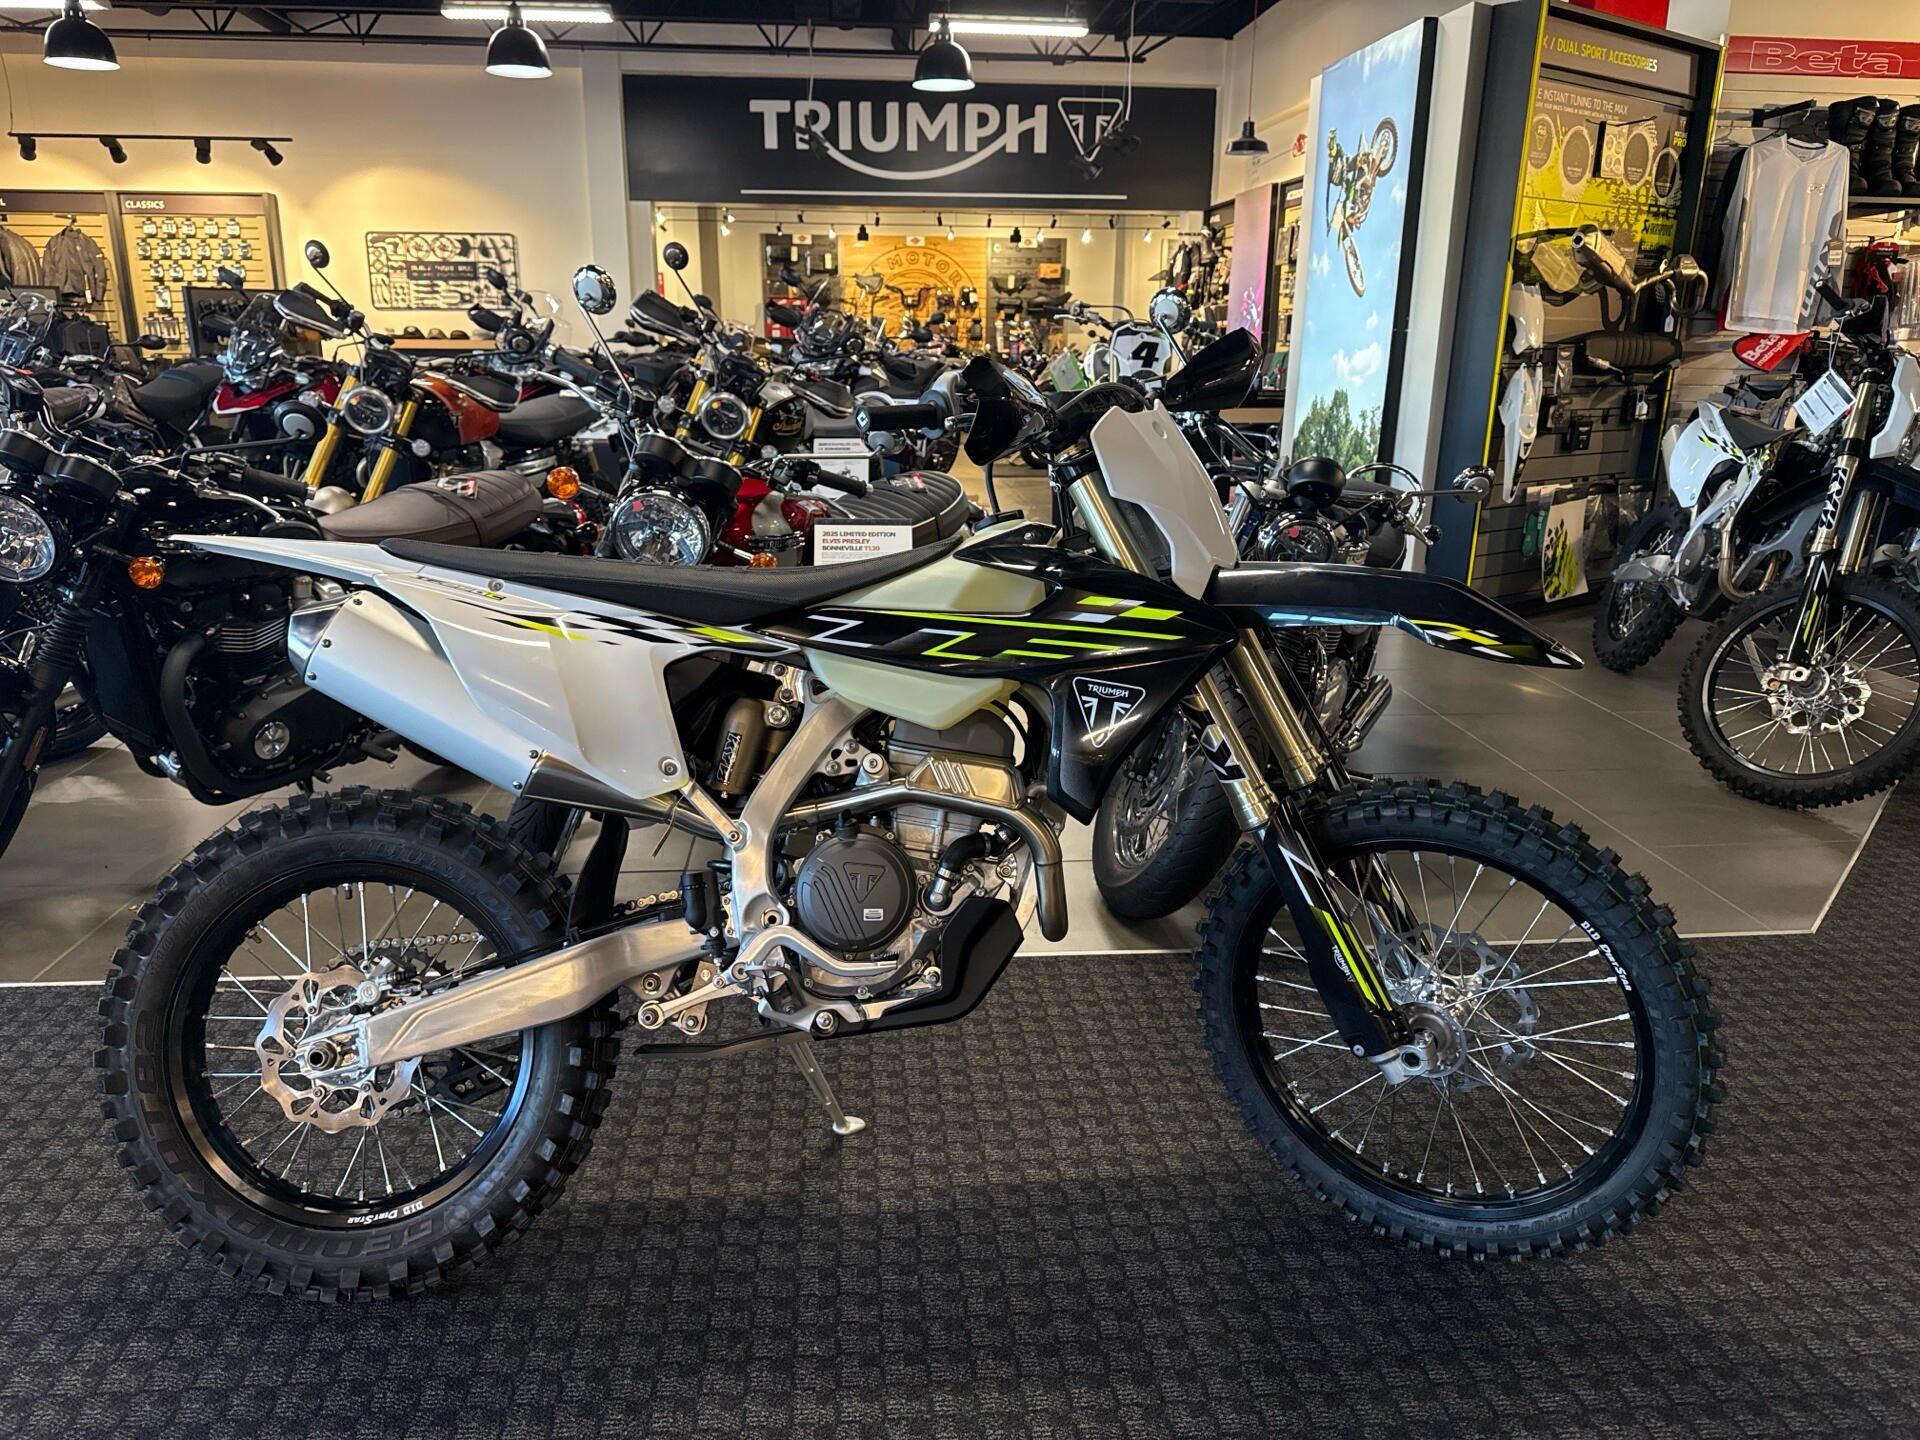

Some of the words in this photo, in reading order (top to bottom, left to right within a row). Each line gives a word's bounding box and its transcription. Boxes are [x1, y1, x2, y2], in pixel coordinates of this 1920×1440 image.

[1557, 38, 1579, 55] DUAL
[1581, 43, 1607, 61] SPORT
[1608, 51, 1658, 72] ACCESSORIES
[1750, 41, 1903, 75] Beta
[1543, 89, 1570, 104] INSTANT
[1570, 94, 1593, 110] TUNING
[1594, 98, 1602, 110] TO
[1602, 100, 1615, 113] THE
[1615, 102, 1630, 115] MAX
[749, 99, 1048, 156] TRIUMPH
[125, 200, 165, 210] CLASSICS
[888, 251, 962, 287] MOTOR
[1130, 341, 1160, 368] 4
[1741, 332, 1781, 362] Beta
[1088, 683, 1129, 699] TRIUMPH
[1331, 944, 1351, 977] TRIUMPH
